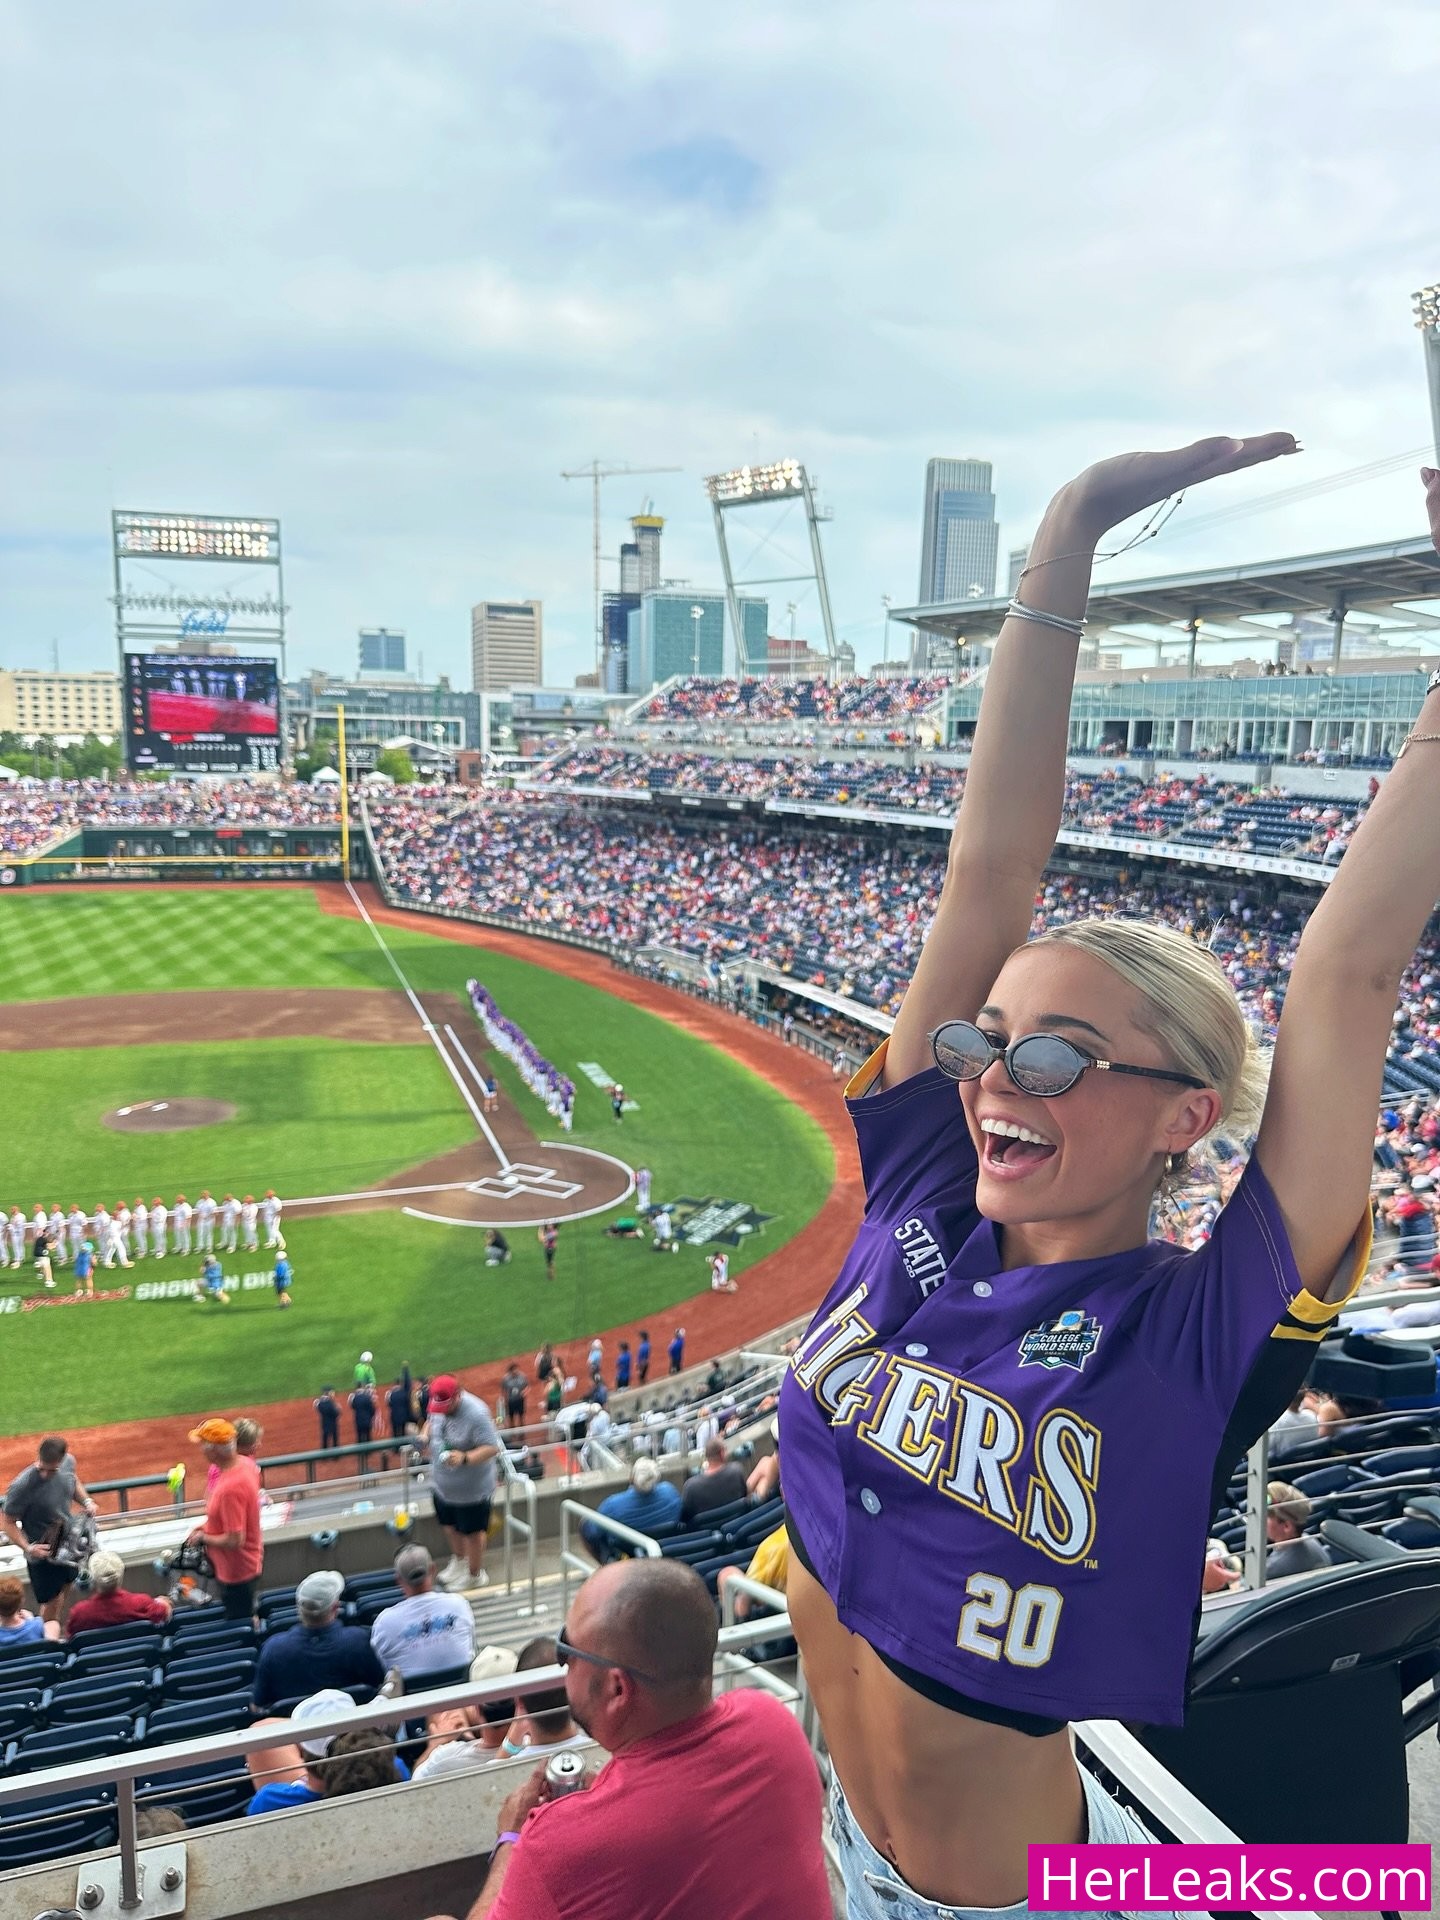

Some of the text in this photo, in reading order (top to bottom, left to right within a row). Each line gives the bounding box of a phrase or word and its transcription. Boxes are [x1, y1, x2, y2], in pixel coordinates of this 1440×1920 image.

[894, 1218, 948, 1297] STATE
[1040, 1333, 1081, 1343] COLLEGE
[1023, 1342, 1093, 1351] WORLD SERIES
[1083, 1558, 1099, 1570] TM
[957, 1571, 1064, 1668] 20
